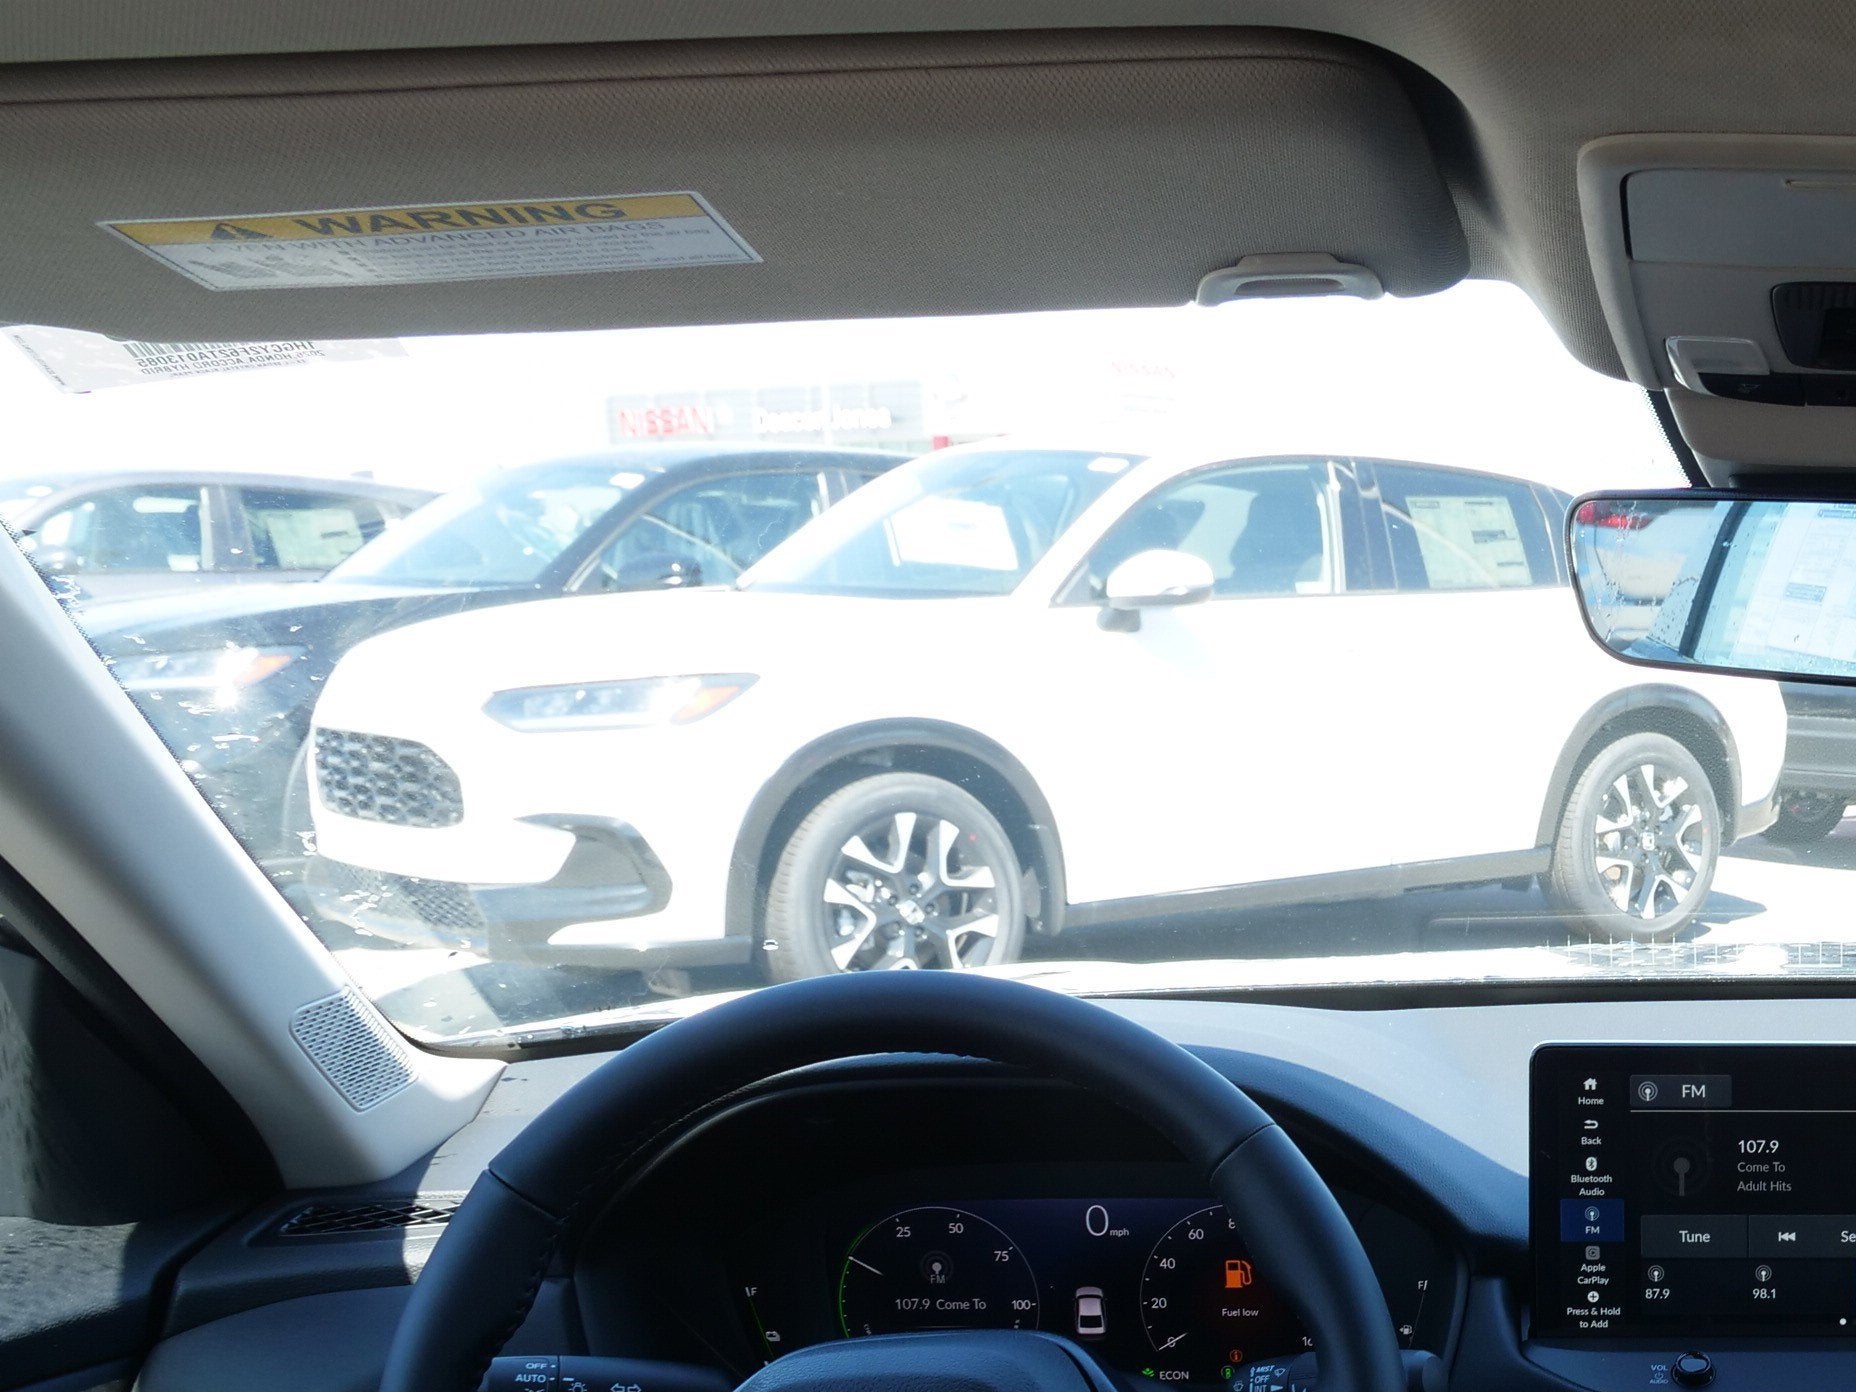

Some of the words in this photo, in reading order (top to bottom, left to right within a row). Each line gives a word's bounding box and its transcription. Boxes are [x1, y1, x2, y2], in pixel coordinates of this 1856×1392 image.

[293, 203, 627, 235] WARNING
[374, 228, 525, 246] ADVANCED
[534, 225, 580, 236] AIR
[590, 221, 666, 233] BAGS
[617, 405, 714, 437] NISSAN
[1682, 1084, 1706, 1098] FM
[1577, 1097, 1605, 1105] Home
[1581, 1136, 1602, 1145] Back
[1738, 1140, 1779, 1154] 107.9
[1737, 1161, 1770, 1173] Come
[1773, 1161, 1786, 1173] To
[1571, 1174, 1613, 1183] Bluetooth
[1579, 1187, 1605, 1196] Audio
[1737, 1180, 1767, 1192] Adult
[1770, 1180, 1792, 1192] Hits
[1086, 1204, 1109, 1236] 0
[896, 1226, 911, 1238] 25
[949, 1222, 964, 1234] 50
[1109, 1226, 1130, 1238] mph
[1585, 1226, 1600, 1234] FM
[1188, 1229, 1204, 1240] 60
[1679, 1230, 1711, 1243] Tune
[994, 1250, 1009, 1262] 75
[1159, 1258, 1176, 1270] 40
[1580, 1263, 1606, 1273] Apple
[930, 1274, 946, 1284] FM
[1577, 1276, 1609, 1286] CarPlay
[1645, 1288, 1670, 1300] 87.9
[1752, 1288, 1776, 1299] 98.1
[895, 1298, 930, 1311] 107.9
[936, 1299, 969, 1311] Come
[972, 1299, 987, 1311] To
[1011, 1299, 1031, 1311] 100
[1151, 1297, 1168, 1309] 20
[1221, 1308, 1240, 1317] Fuel
[1242, 1308, 1259, 1317] low
[1566, 1307, 1589, 1316] Press
[1590, 1307, 1598, 1316] &
[1600, 1307, 1621, 1316] Hold
[1579, 1320, 1588, 1328] to
[1590, 1319, 1609, 1328] Add
[525, 1362, 547, 1370] OFF
[515, 1374, 547, 1383] AUTO
[1159, 1370, 1189, 1381] ECON
[1254, 1375, 1270, 1384] OFF
